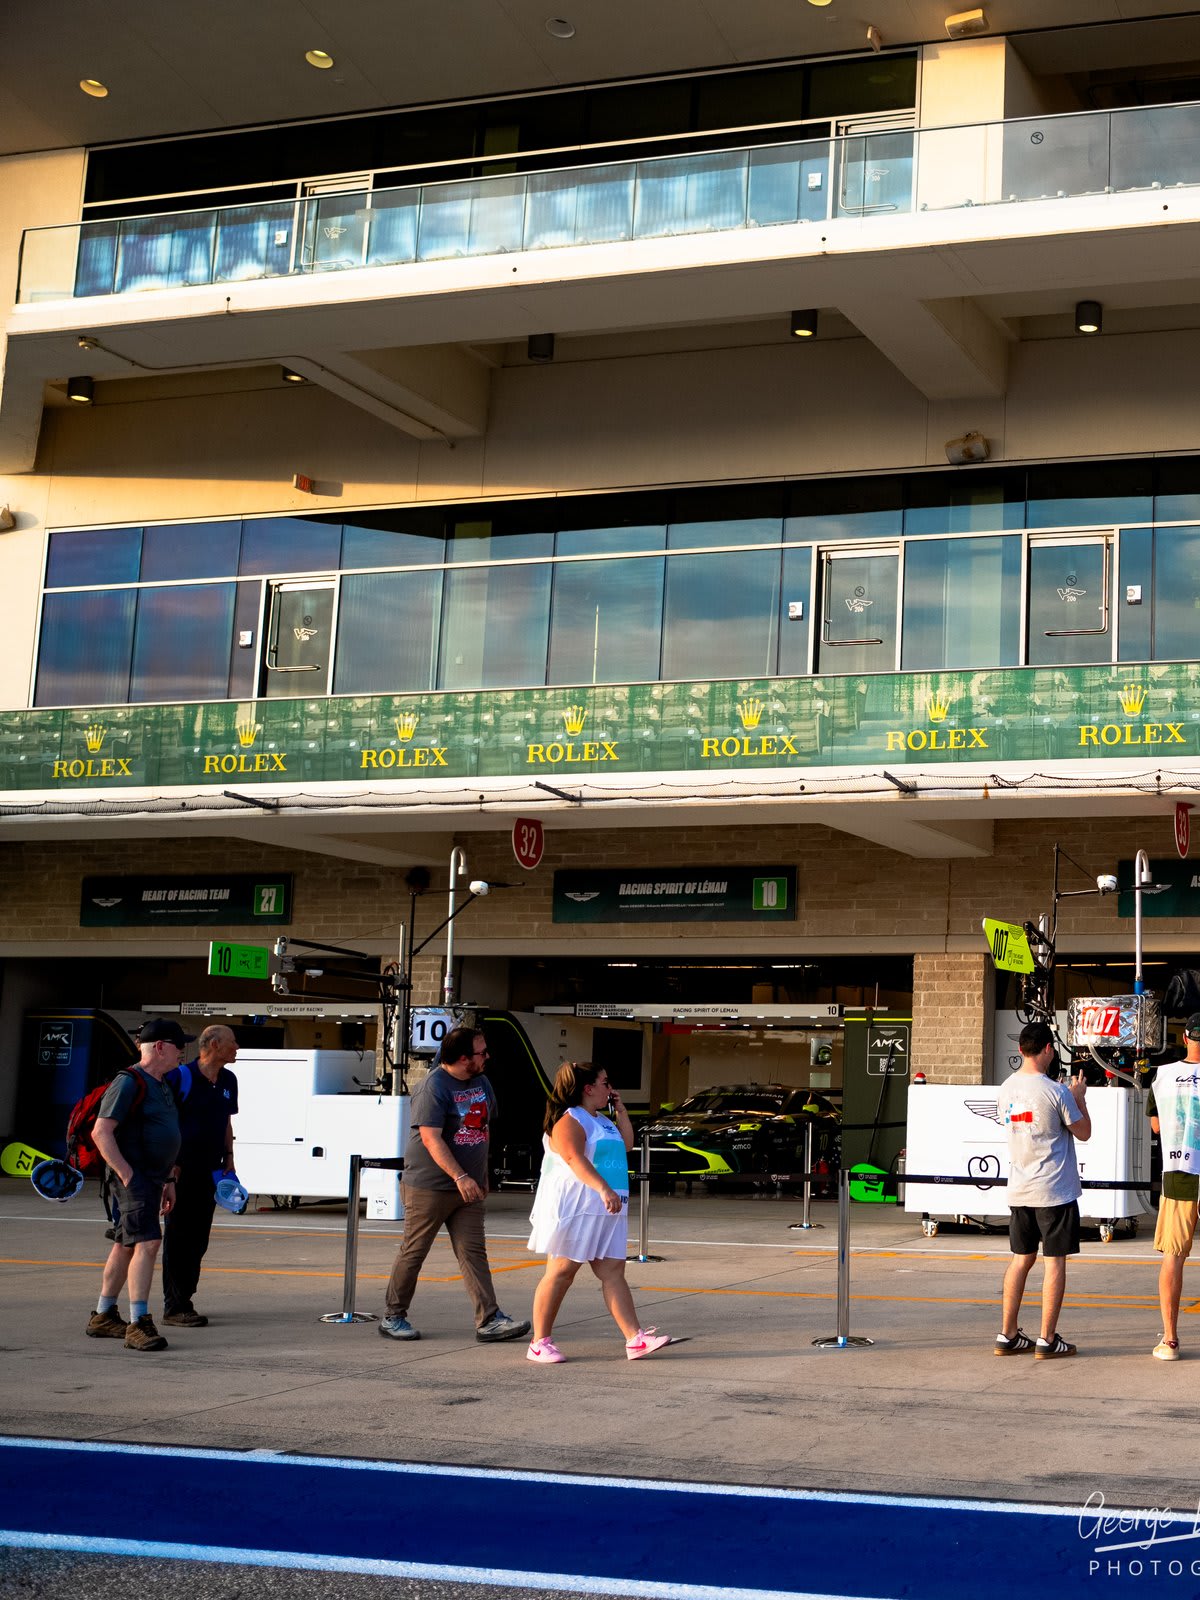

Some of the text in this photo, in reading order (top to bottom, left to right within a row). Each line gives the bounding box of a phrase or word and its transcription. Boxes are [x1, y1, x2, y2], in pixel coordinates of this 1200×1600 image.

[889, 729, 987, 751] ROLEX
[1080, 723, 1185, 746] ROLEX
[361, 747, 447, 769] ROLEX
[527, 742, 619, 764] ROLEX
[702, 736, 798, 758] ROLEX
[53, 758, 130, 778] ROLEX
[204, 753, 287, 773] ROLEX
[520, 824, 536, 859] 32
[141, 888, 230, 901] HEART OF RACING TEAM
[618, 880, 728, 896] RACING SPIRIT OF LÉMAN
[761, 881, 778, 907] 10
[260, 888, 277, 912] 27
[993, 928, 1009, 962] 007
[217, 946, 231, 973] 10
[827, 1005, 837, 1016] 10
[1083, 1009, 1119, 1033] 007
[416, 1020, 448, 1042] 10
[16, 1150, 32, 1171] 27
